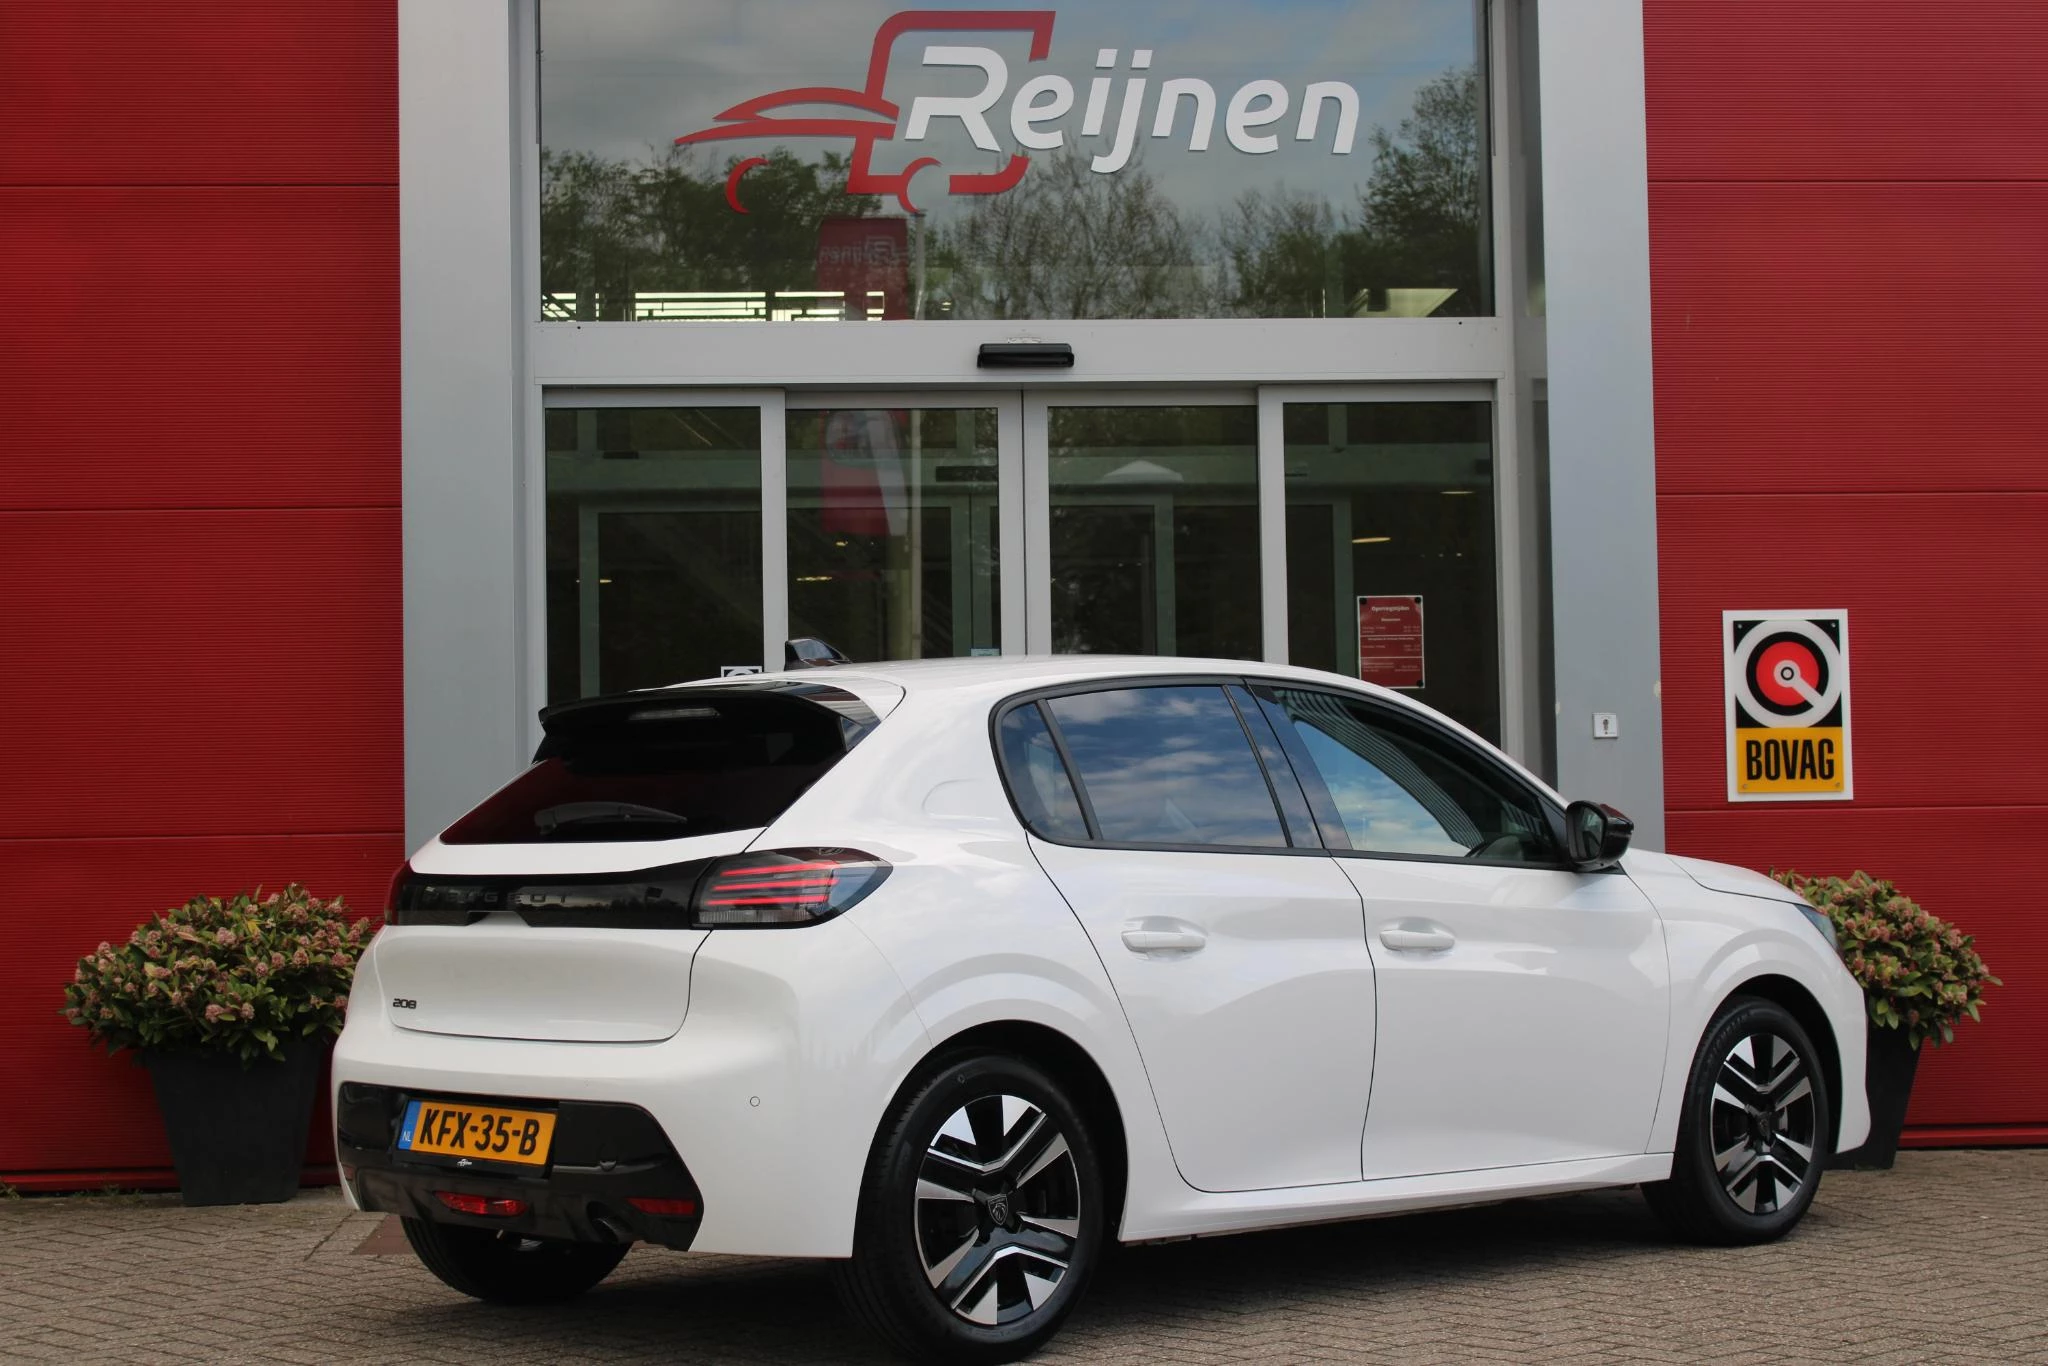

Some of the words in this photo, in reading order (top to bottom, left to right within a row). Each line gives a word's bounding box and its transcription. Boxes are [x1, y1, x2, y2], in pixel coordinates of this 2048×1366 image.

[905, 46, 1361, 174] Reijnen
[1746, 738, 1835, 781] BOVAG
[392, 998, 417, 1010] 208
[402, 1131, 412, 1142] NL
[419, 1108, 540, 1156] KFX-35-B
